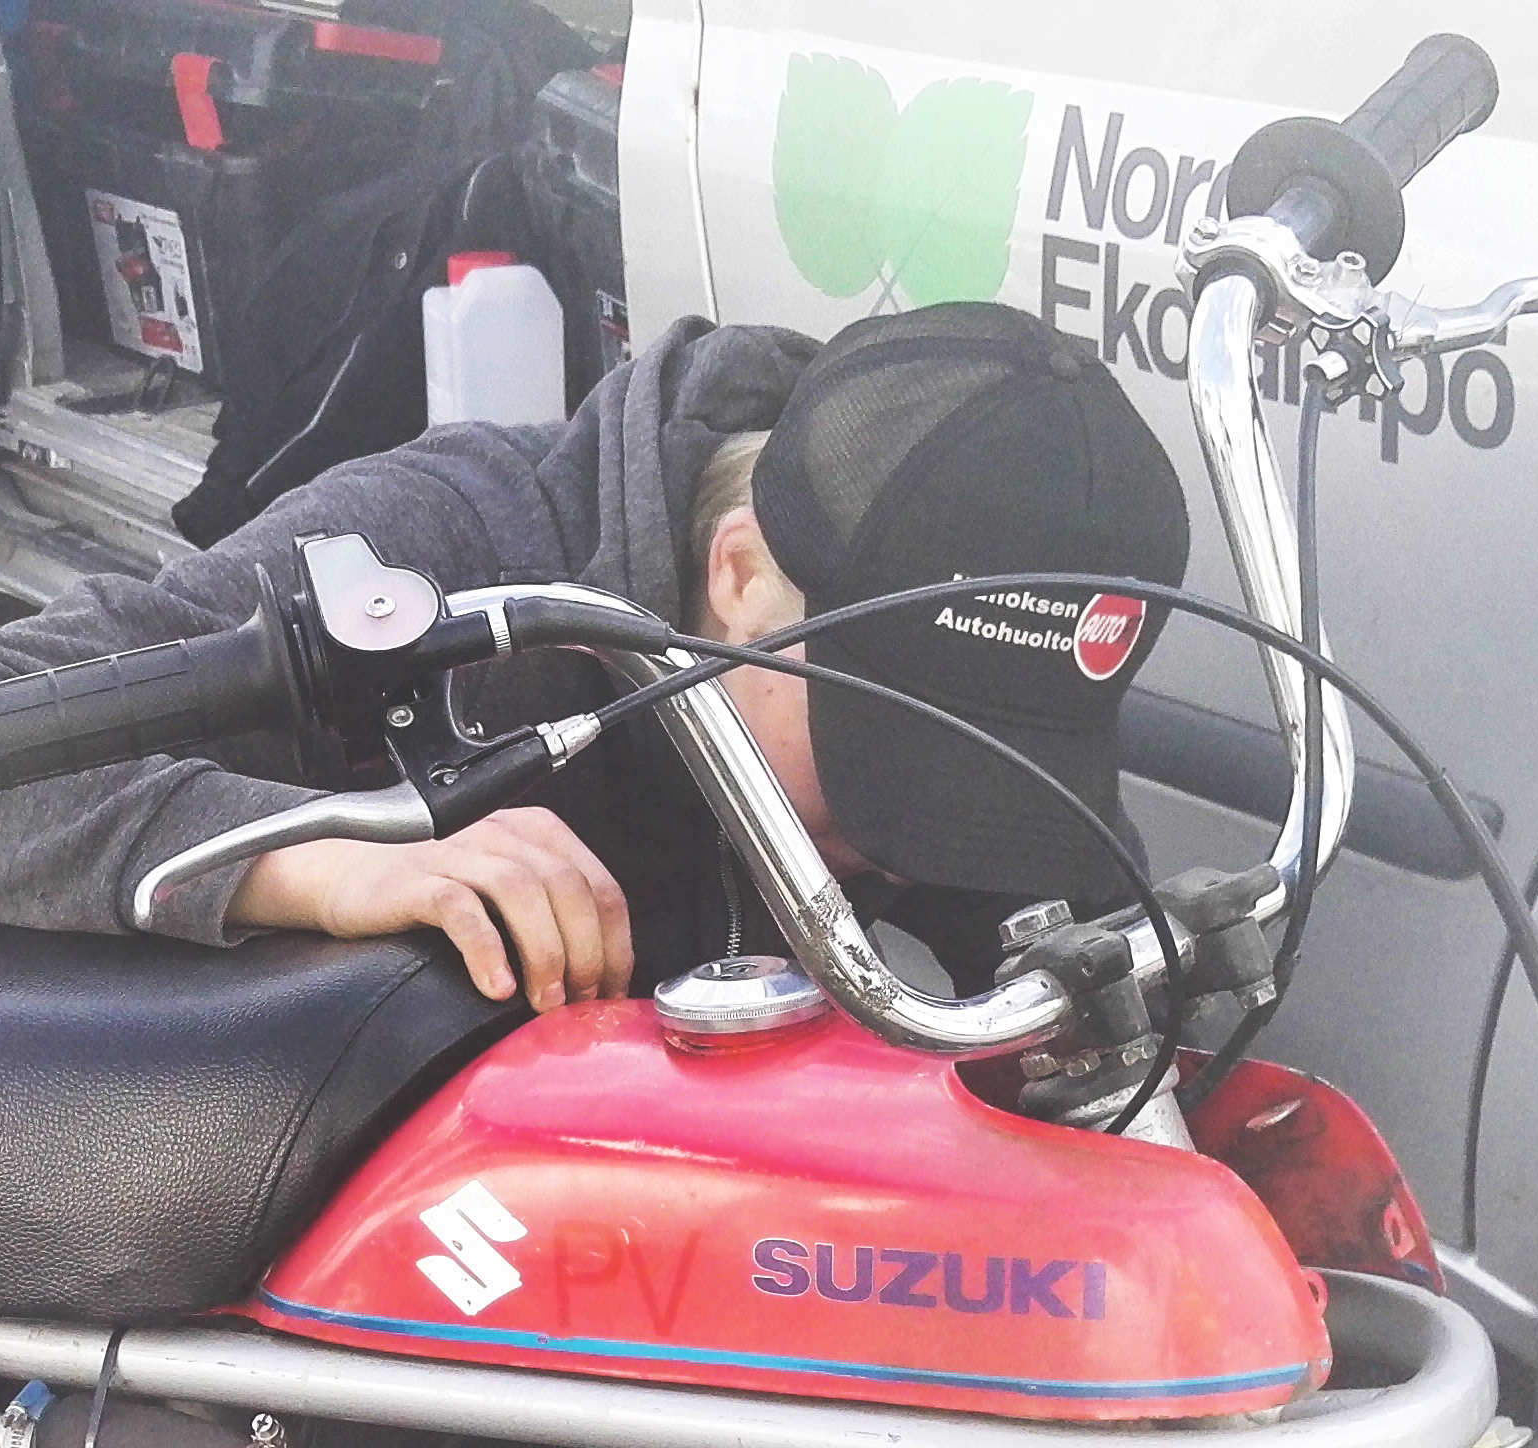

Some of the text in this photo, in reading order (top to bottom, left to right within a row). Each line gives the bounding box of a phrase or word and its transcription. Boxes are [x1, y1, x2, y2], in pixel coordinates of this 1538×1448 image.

[1045, 103, 1231, 246] Nor
[934, 606, 1073, 652] Autohuolto
[1078, 612, 1128, 645] AUTO
[752, 1237, 1108, 1321] SUZUKI
